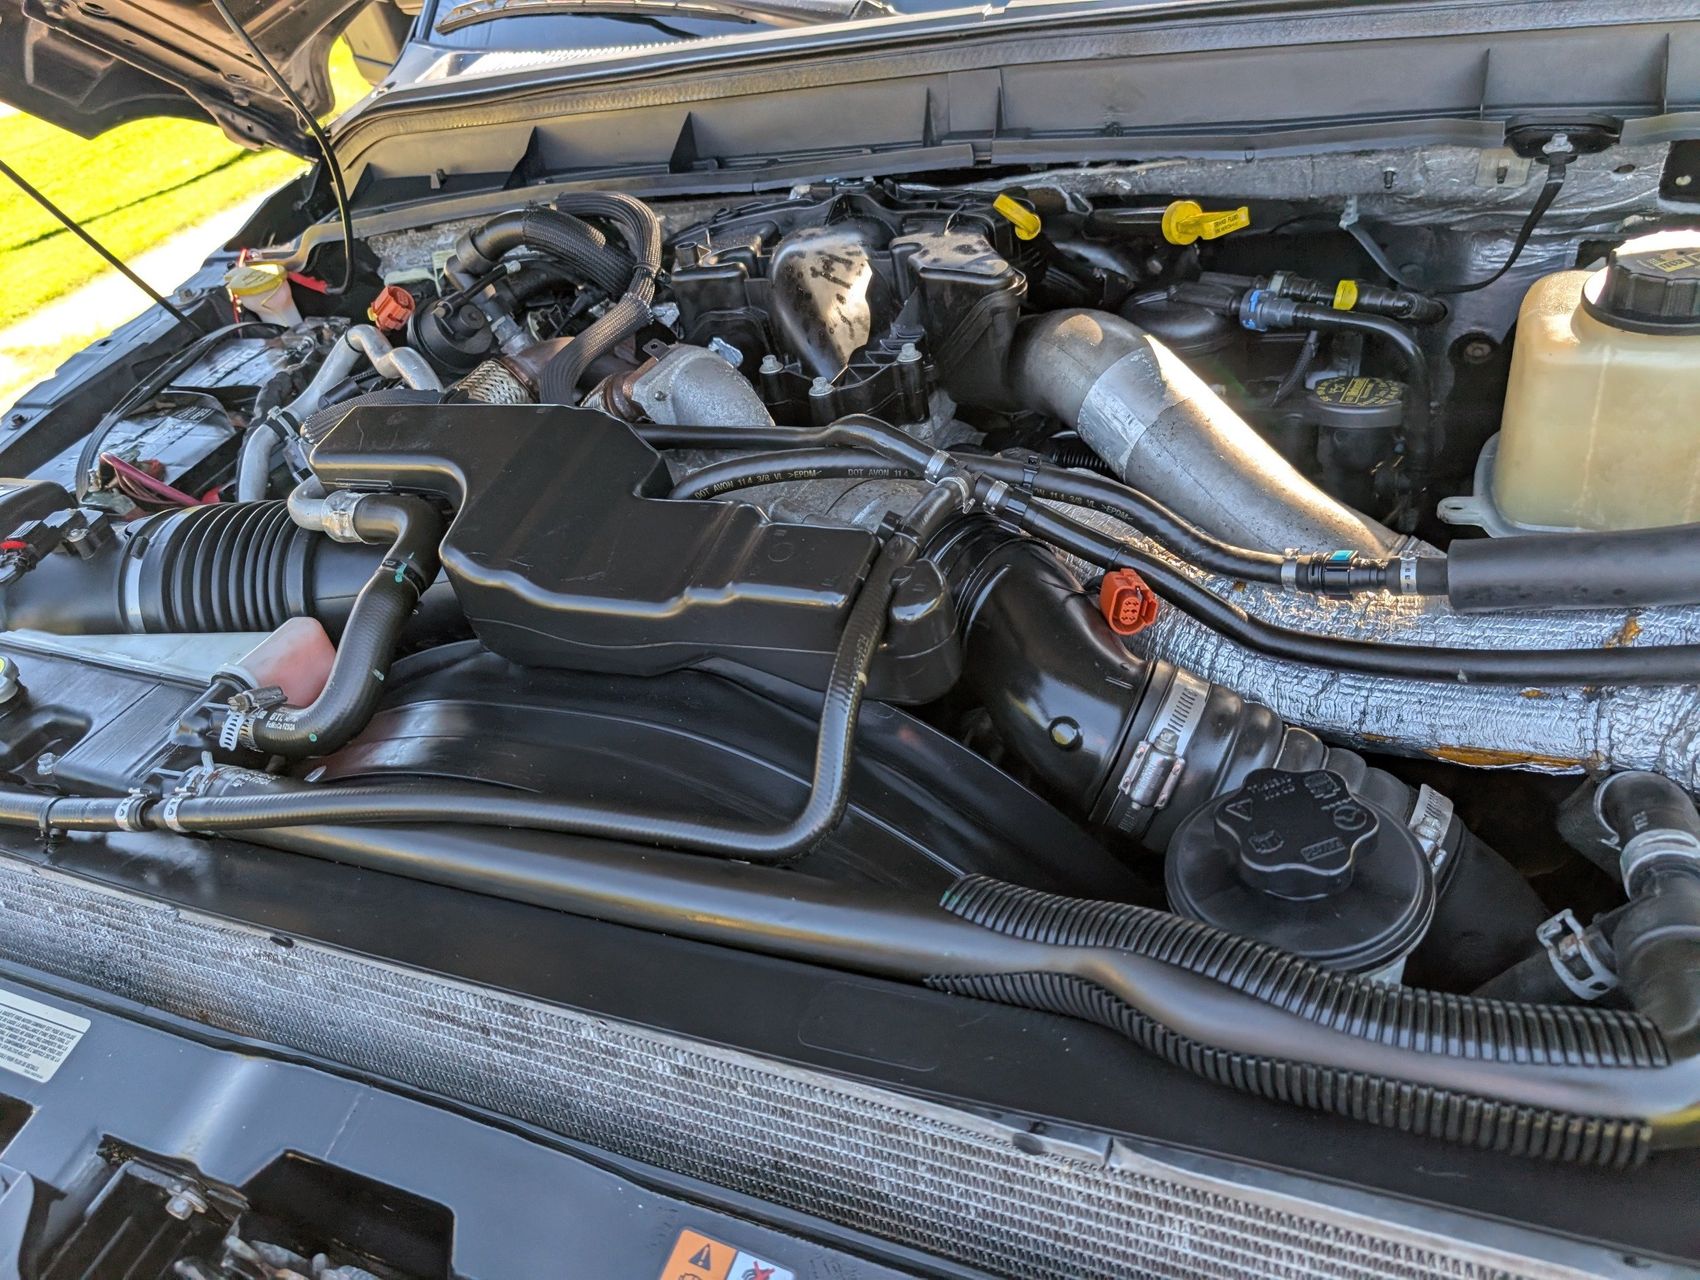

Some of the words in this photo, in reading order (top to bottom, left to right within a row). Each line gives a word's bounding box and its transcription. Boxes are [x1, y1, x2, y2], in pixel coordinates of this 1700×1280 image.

[847, 468, 865, 477] DOT
[868, 468, 890, 477] AVON
[694, 488, 710, 500] DOT
[713, 480, 734, 493] AVON
